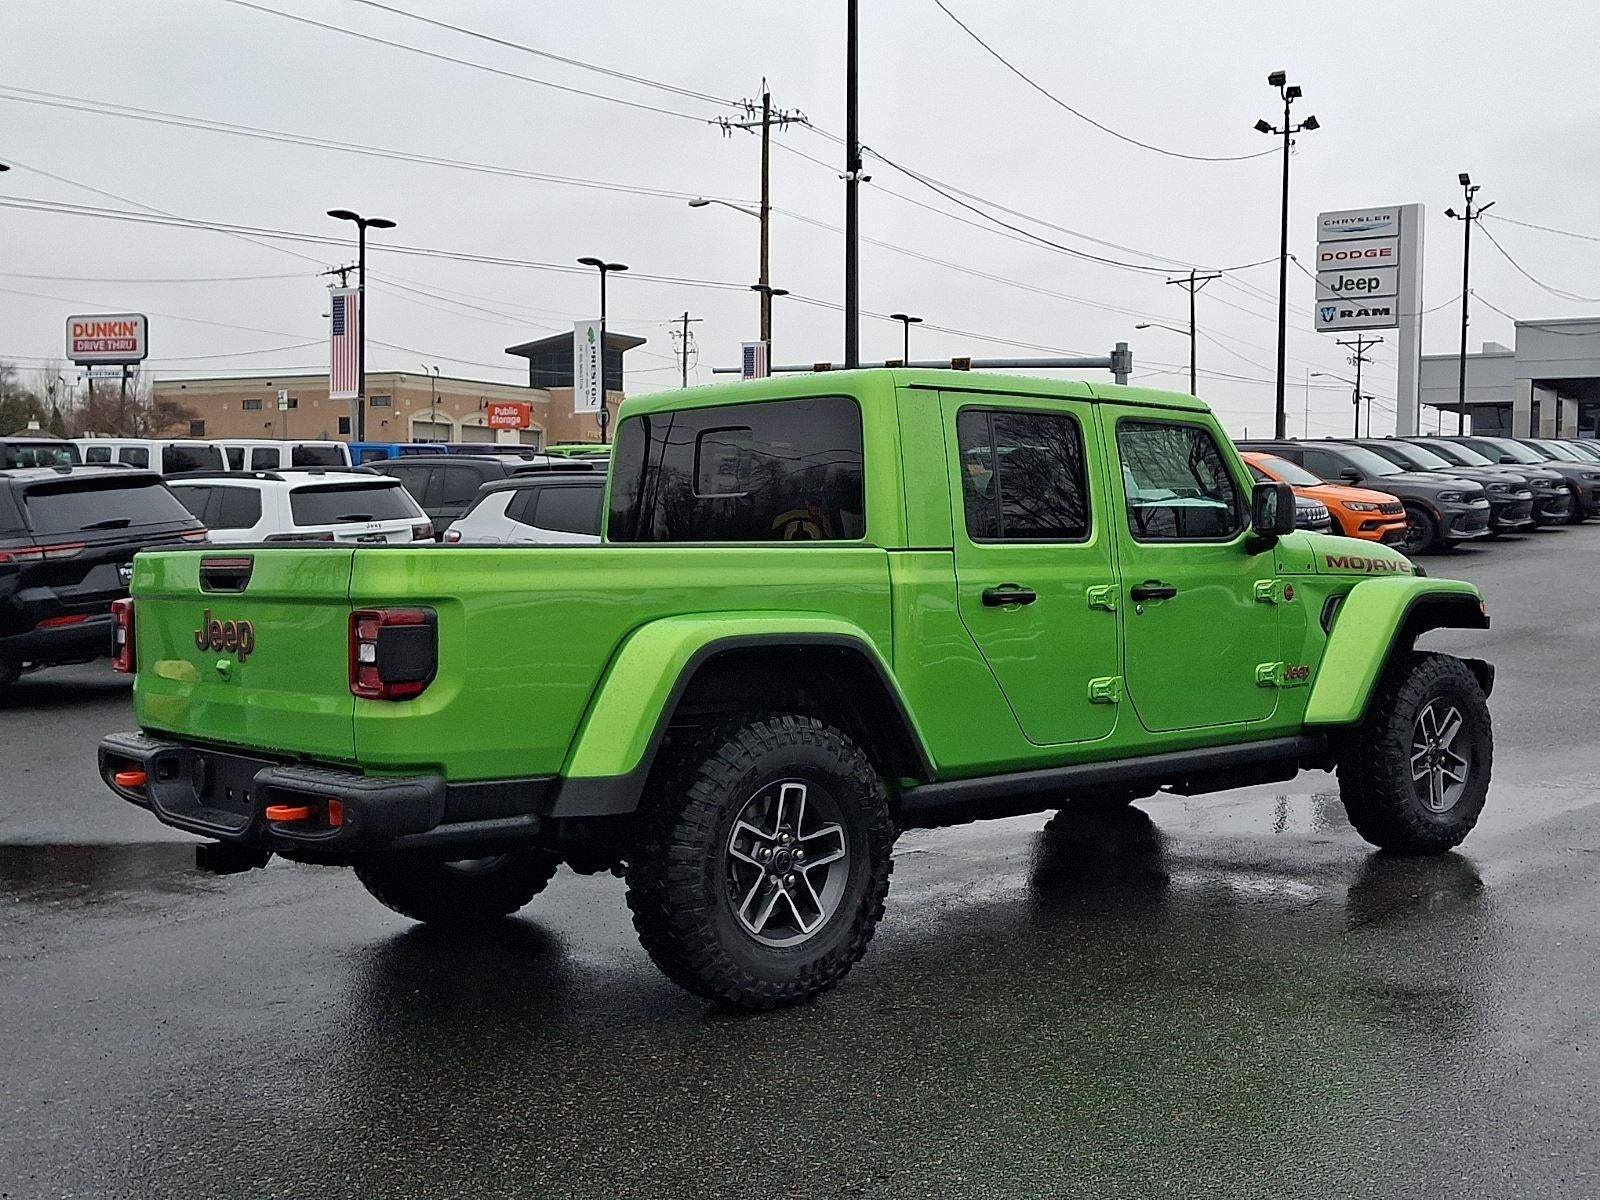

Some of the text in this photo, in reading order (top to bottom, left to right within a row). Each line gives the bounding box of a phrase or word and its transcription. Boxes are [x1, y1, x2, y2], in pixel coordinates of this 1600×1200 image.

[1324, 215, 1390, 226] CHRYSLER
[1321, 248, 1392, 261] DODGE
[1331, 275, 1380, 293] Jeep
[1340, 307, 1390, 318] RAM
[73, 321, 138, 337] DUNKIN'
[77, 339, 133, 351] DRIVE THRU
[494, 406, 518, 416] Public
[491, 415, 521, 426] Storage
[1325, 555, 1410, 573] MOJAVE
[194, 608, 255, 663] Jeep
[1284, 663, 1309, 681] Jeep
